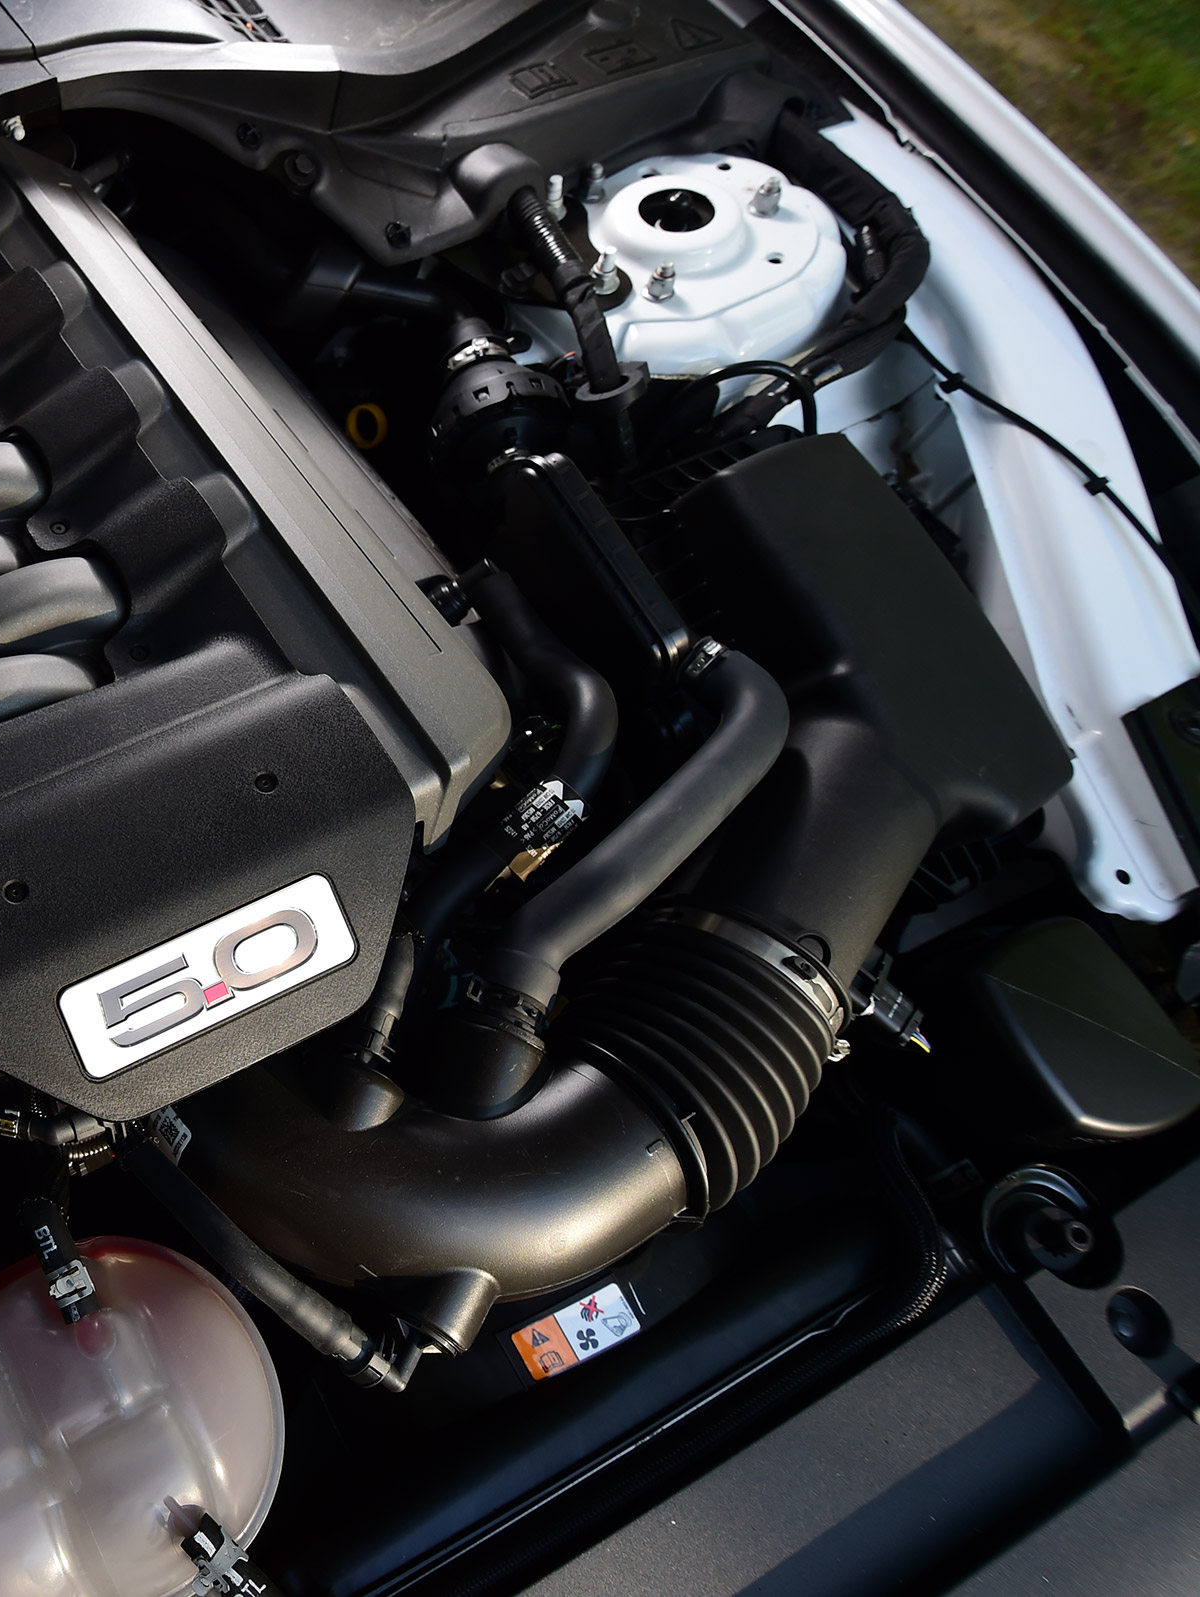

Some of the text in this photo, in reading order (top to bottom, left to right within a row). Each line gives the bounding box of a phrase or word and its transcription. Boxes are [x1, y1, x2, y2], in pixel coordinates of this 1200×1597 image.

[539, 804, 564, 829] FoMoCo
[97, 906, 319, 1048] 5.0
[34, 1224, 58, 1260] BTL
[233, 1578, 267, 1597] TL
